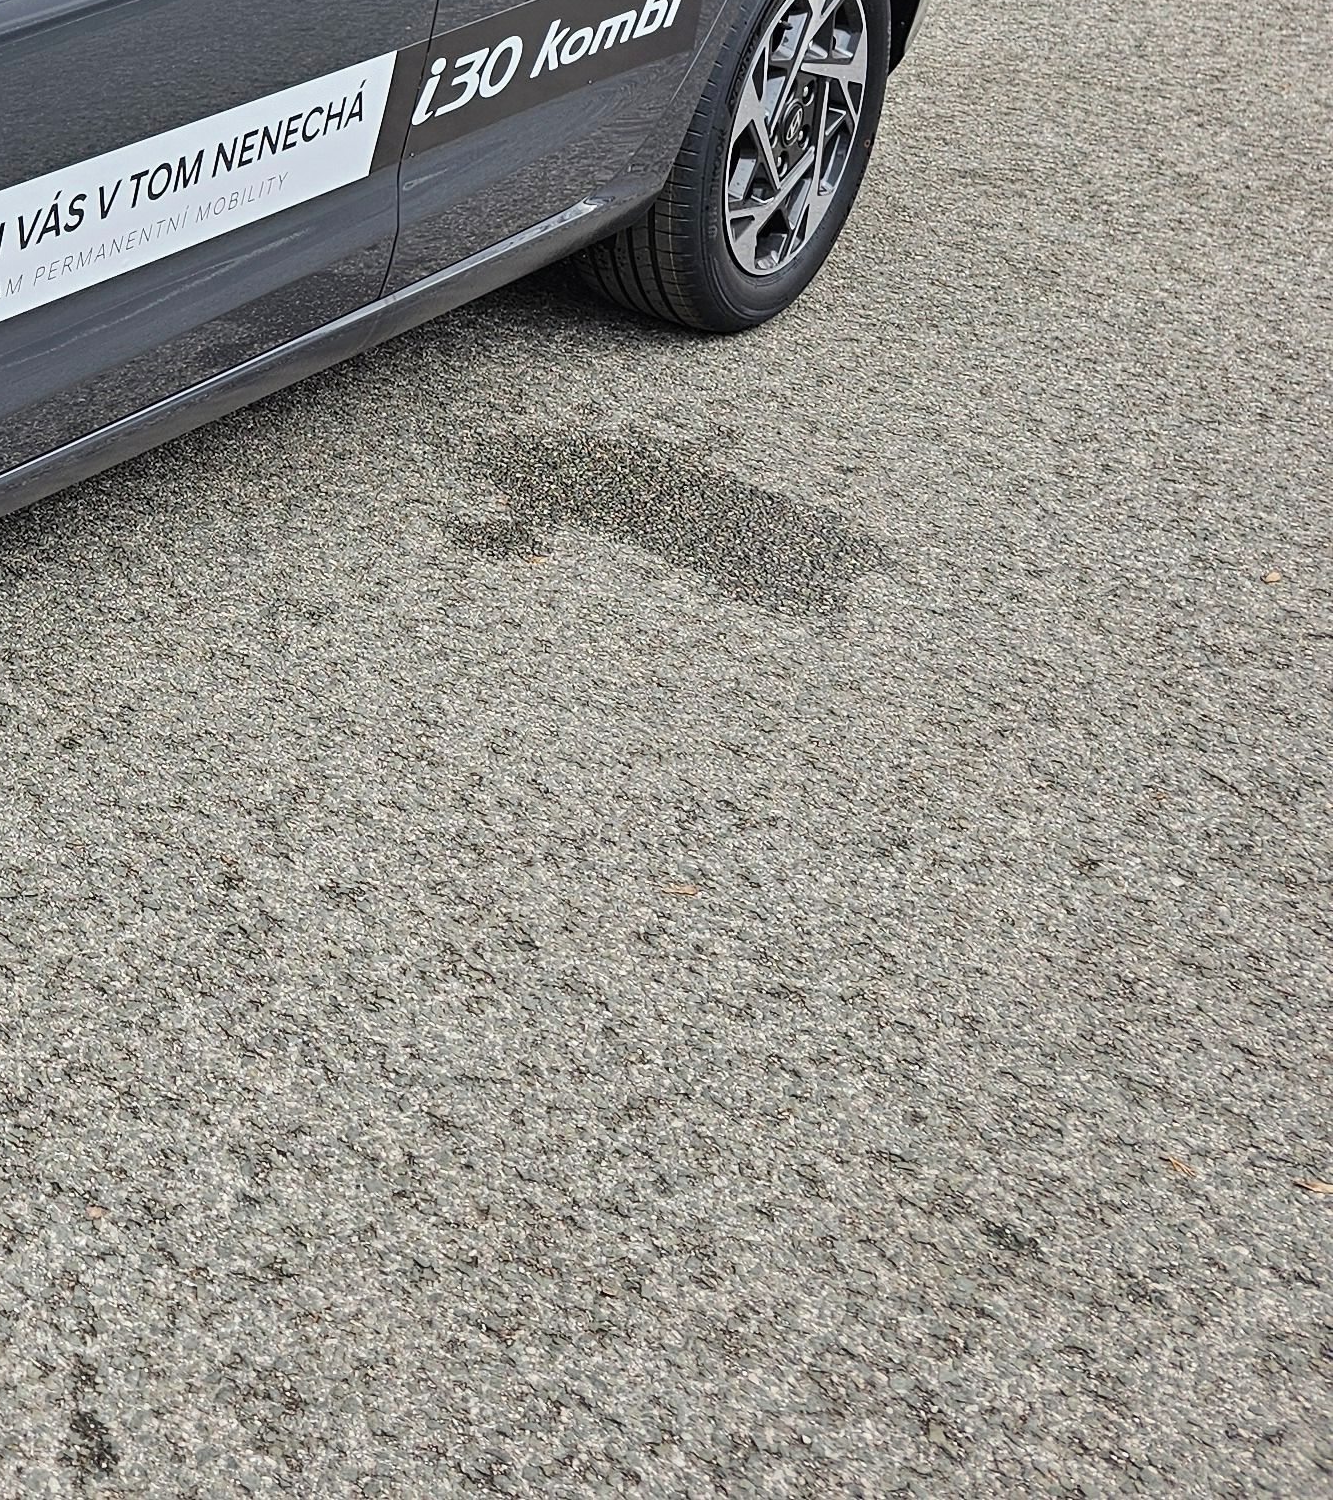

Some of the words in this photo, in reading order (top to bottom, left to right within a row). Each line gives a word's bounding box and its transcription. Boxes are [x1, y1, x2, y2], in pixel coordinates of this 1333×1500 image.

[411, 35, 524, 126] i30
[17, 190, 87, 252] VÁS
[98, 179, 122, 220] V
[128, 150, 205, 209] TOM
[211, 79, 367, 178] NENECHÁ
[33, 206, 190, 287] PERMANENTNÍ
[195, 171, 289, 224] MOBILITY
